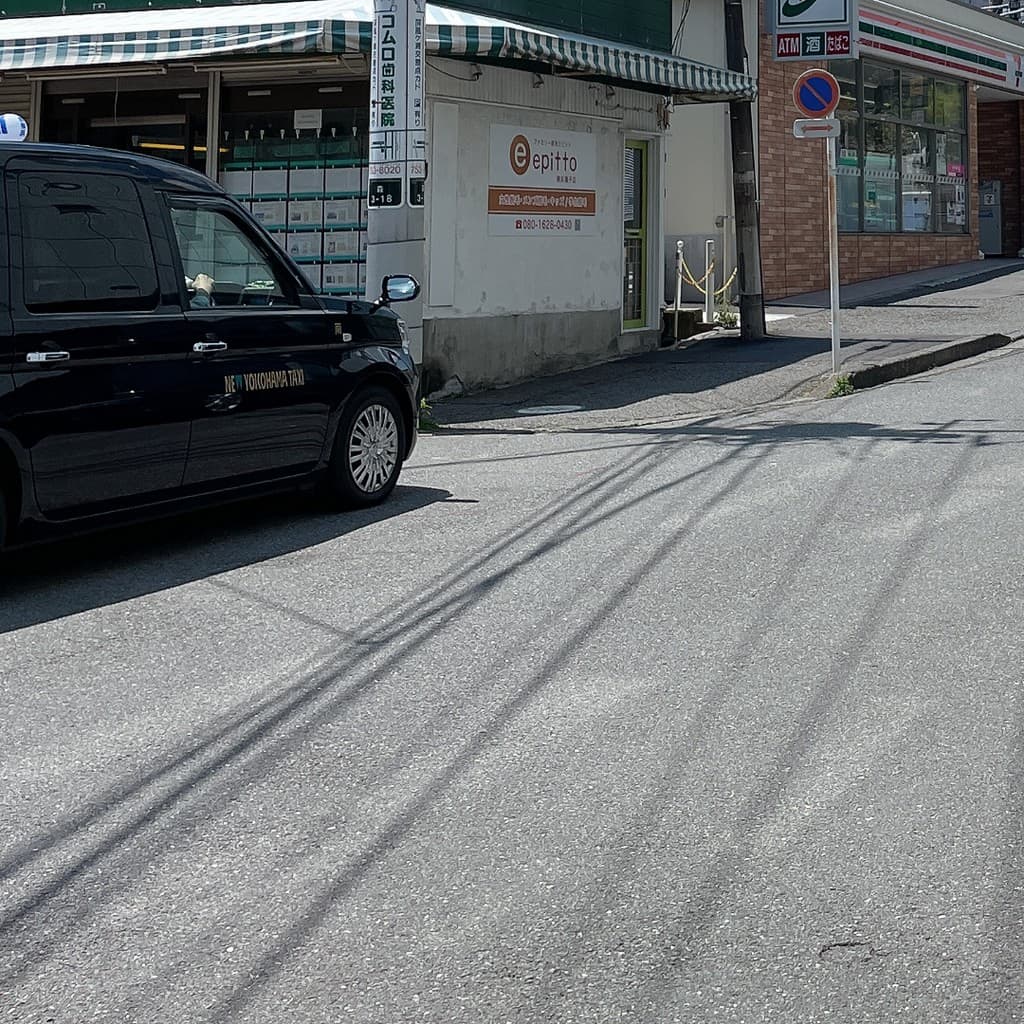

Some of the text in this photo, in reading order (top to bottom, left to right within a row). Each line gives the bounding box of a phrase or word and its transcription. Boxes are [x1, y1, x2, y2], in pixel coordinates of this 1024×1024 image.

[778, 37, 799, 54] ATM
[806, 36, 820, 52] 酒
[827, 35, 849, 52] たばこ
[381, 15, 396, 127] コムロ歯科医院
[532, 151, 578, 174] epitto
[523, 219, 572, 230] 080-1628-0430
[243, 370, 288, 391] YOKOHAMA
[287, 369, 305, 386] TAXI
